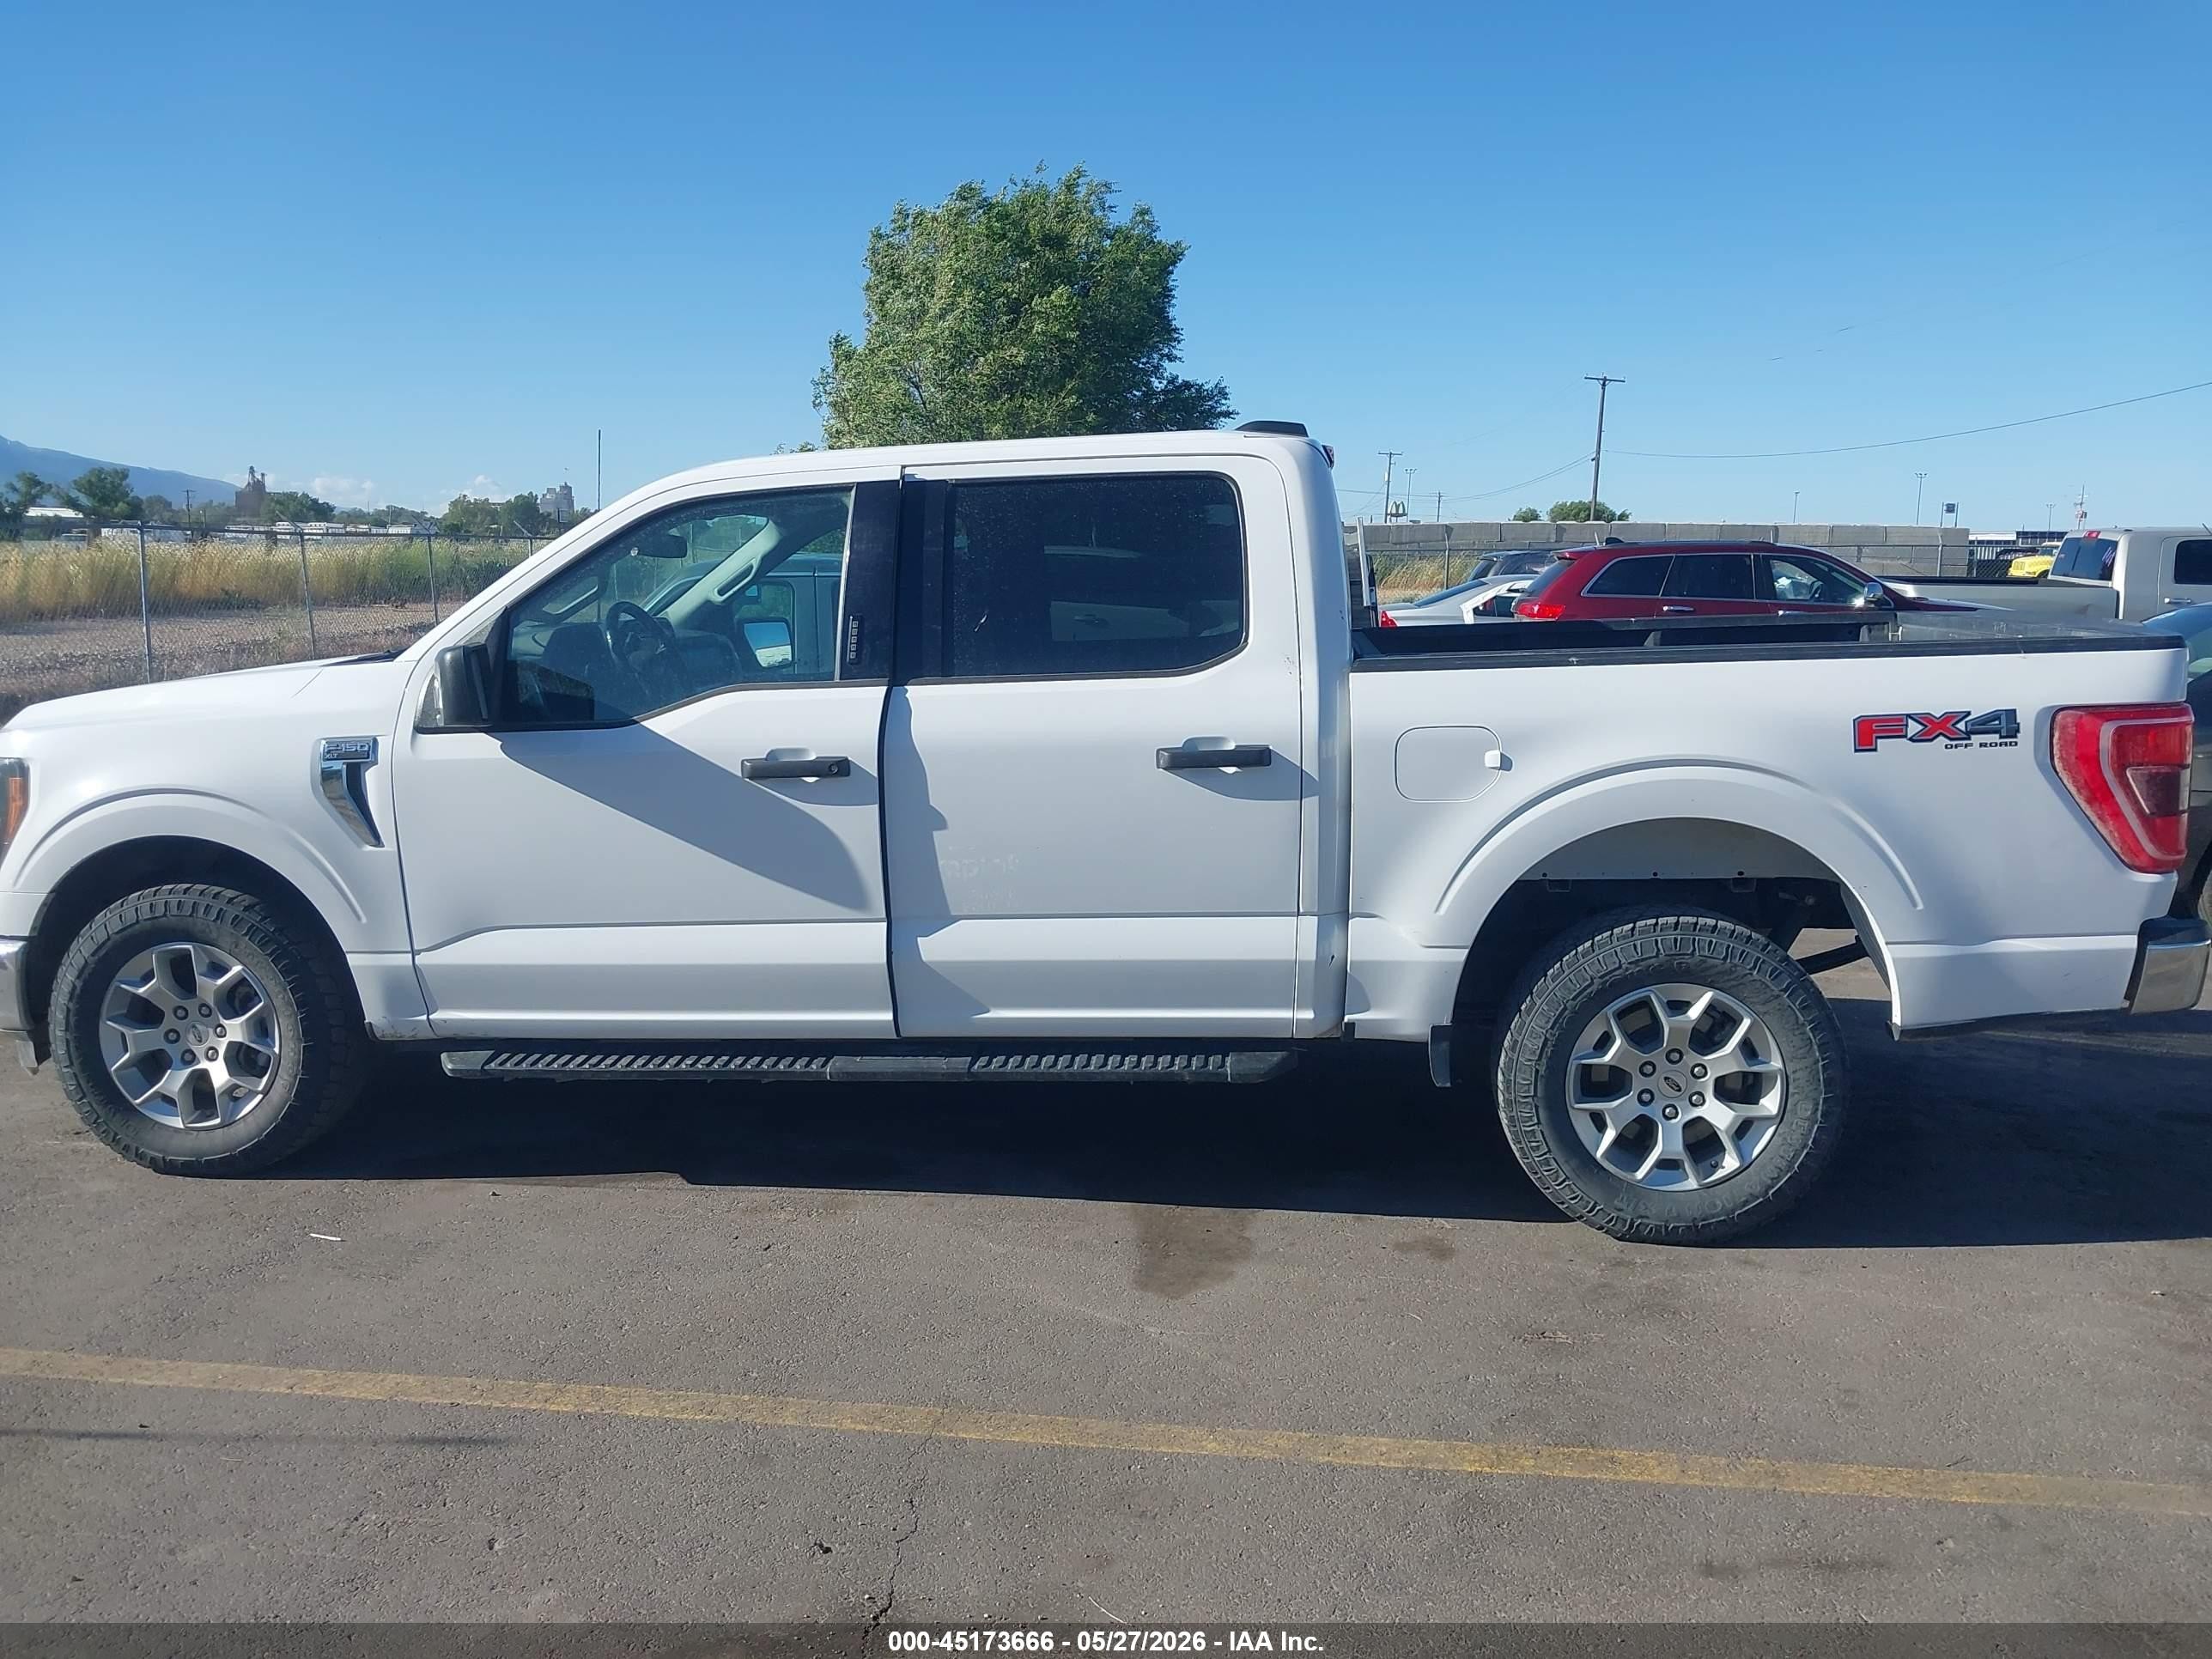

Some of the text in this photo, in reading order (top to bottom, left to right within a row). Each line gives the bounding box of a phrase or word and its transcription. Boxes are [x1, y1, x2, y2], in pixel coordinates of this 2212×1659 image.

[1853, 708, 2021, 753] FX4
[325, 742, 370, 752] F-150
[1978, 740, 2018, 749] ROAD
